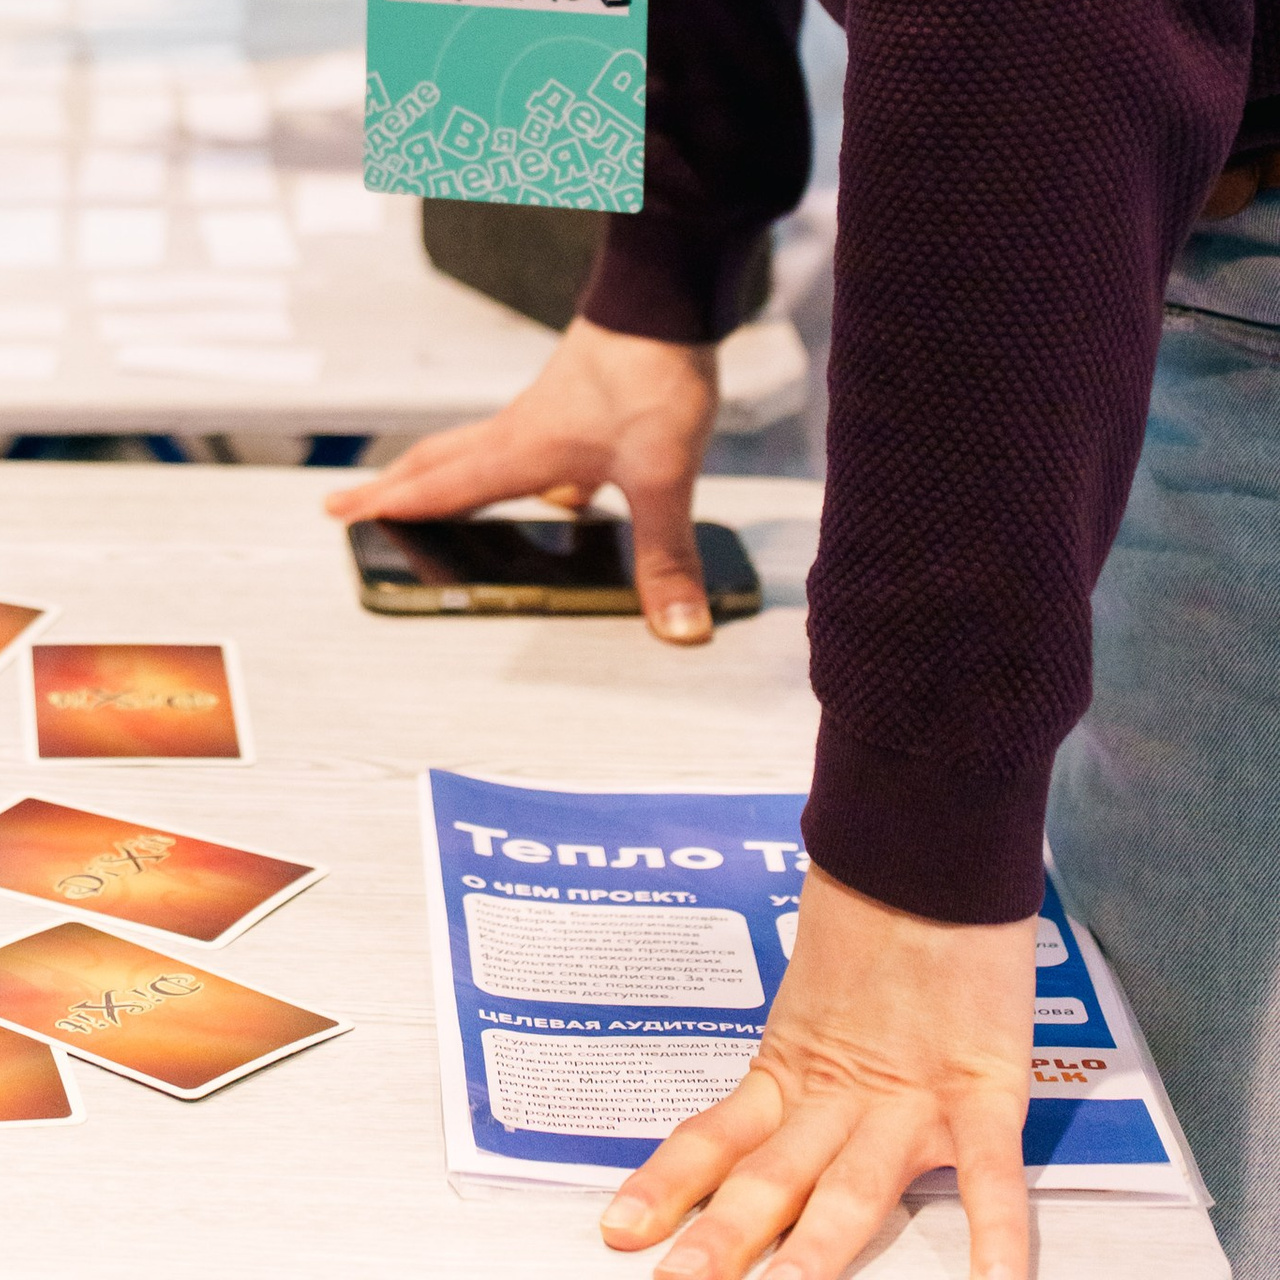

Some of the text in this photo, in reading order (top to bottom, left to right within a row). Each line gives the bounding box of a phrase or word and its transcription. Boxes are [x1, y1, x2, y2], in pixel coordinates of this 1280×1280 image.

[453, 820, 725, 870] Тепло
[462, 875, 698, 905] О ЧЕМ ПРОЕКТ:
[638, 947, 736, 956] проводится
[481, 952, 743, 974] факультетов под руководством
[482, 962, 554, 976] опытных
[684, 974, 704, 982] За
[484, 972, 527, 983] этого
[532, 978, 587, 987] сессия
[605, 982, 706, 991] психологом
[485, 981, 577, 995] становится
[478, 1008, 601, 1031] ЦЕЛЕВАЯ
[492, 1034, 568, 1049] Студенты
[495, 1052, 560, 1065] должны
[1031, 1059, 1107, 1069] PLO
[496, 1060, 622, 1076] по-настоящему
[499, 1078, 548, 1091] ритма
[553, 1086, 608, 1094] жизни,
[514, 1090, 656, 1104] ответственности,
[660, 1097, 725, 1105] приход
[502, 1105, 519, 1113] из
[525, 1110, 594, 1120] родного
[599, 1115, 657, 1123] города
[527, 1101, 627, 1112] переживать
